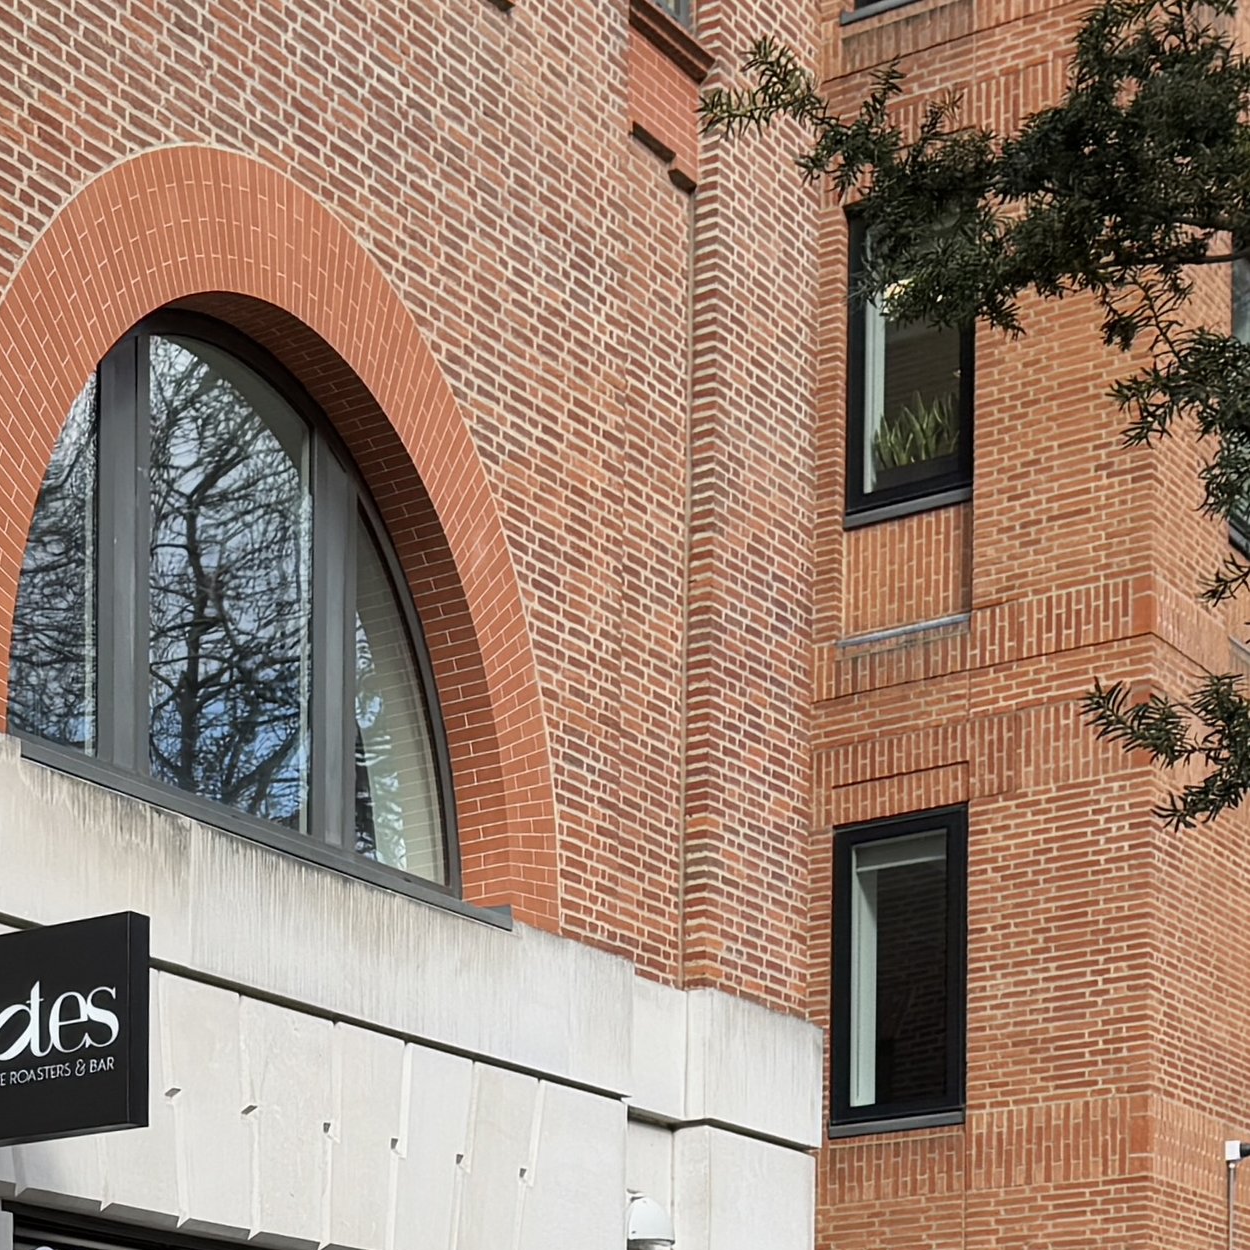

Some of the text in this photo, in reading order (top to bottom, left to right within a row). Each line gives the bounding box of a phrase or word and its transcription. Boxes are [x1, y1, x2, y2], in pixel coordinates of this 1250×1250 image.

[9, 1063, 71, 1085] ROASTERS
[75, 1059, 86, 1076] &
[89, 1056, 115, 1073] BAR
